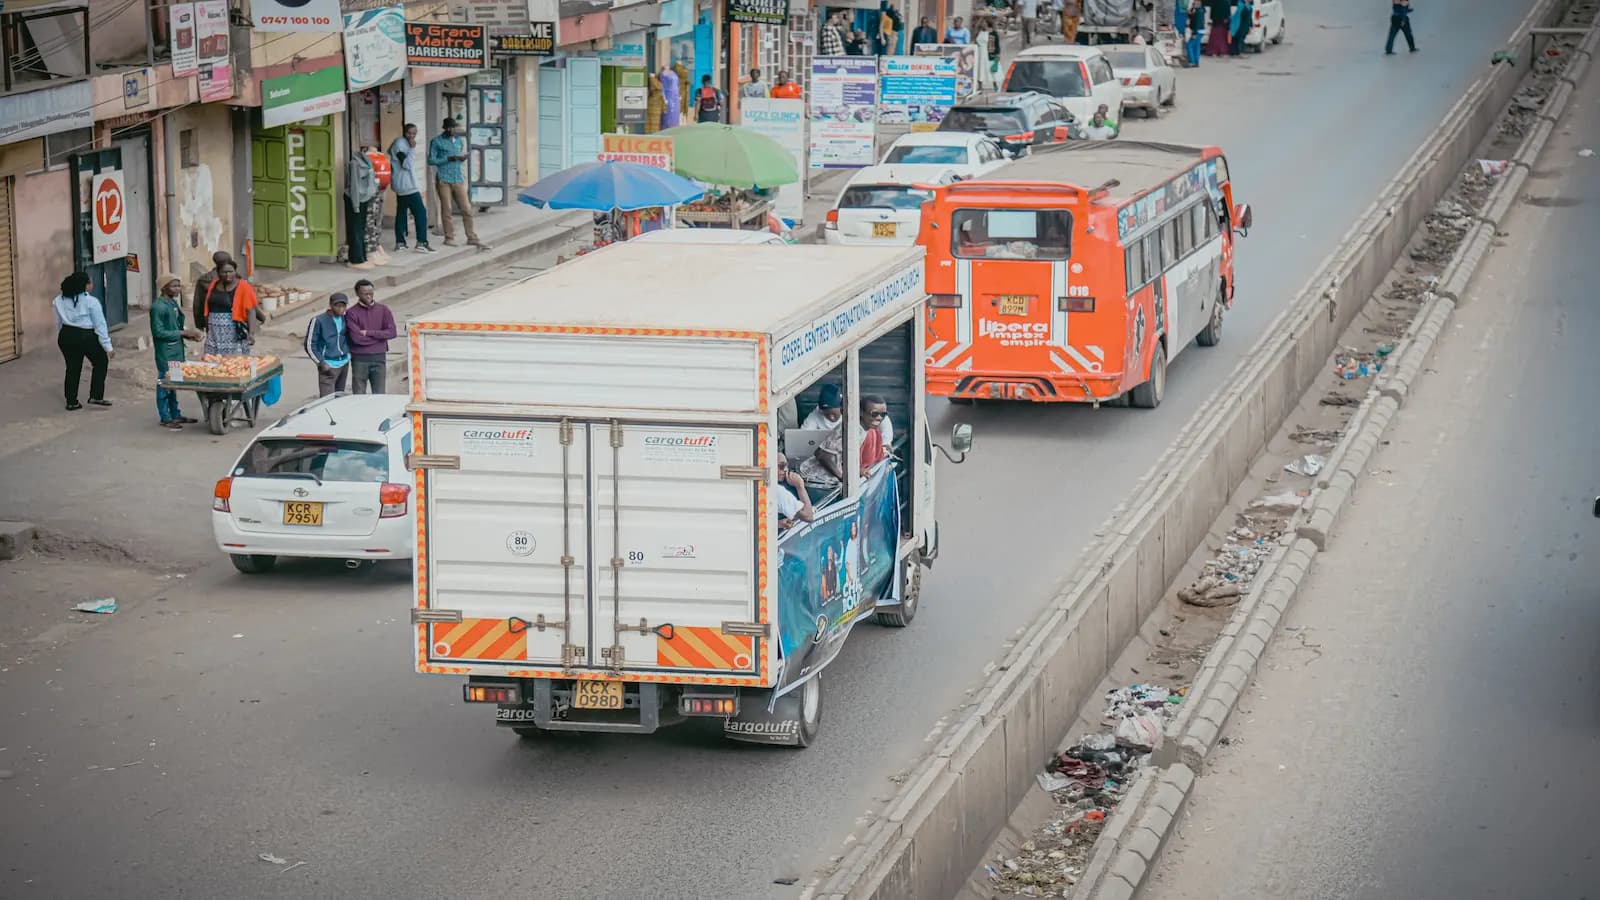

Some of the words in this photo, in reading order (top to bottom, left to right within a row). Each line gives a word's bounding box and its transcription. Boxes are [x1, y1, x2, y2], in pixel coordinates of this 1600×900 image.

[739, 0, 786, 10] WORLD
[747, 6, 784, 16] CYBER
[260, 16, 288, 25] 0747
[291, 17, 309, 25] 100
[312, 17, 330, 25] 100
[428, 25, 481, 38] Grand
[522, 23, 552, 38] ME
[415, 36, 475, 48] Maitre
[407, 46, 483, 59] BARBERSHOP
[934, 64, 957, 72] CLINIC
[287, 133, 310, 240] PESA
[97, 188, 121, 226] 12
[1007, 296, 1024, 305] KCD
[1001, 305, 1024, 313] 899M
[781, 337, 804, 366] GOSPEL
[804, 321, 829, 353] CENTRES
[830, 299, 871, 337] INTERNATIONAL
[870, 287, 887, 313] THIKA
[886, 279, 899, 302] ROAD
[900, 267, 920, 294] CHURCH
[463, 429, 528, 440] cargotuff
[645, 435, 710, 446] cargotuff
[287, 503, 311, 513] KCR
[287, 513, 319, 524] 795V
[514, 536, 528, 545] 80
[628, 551, 644, 561] 80
[579, 694, 619, 707] 098D
[496, 708, 550, 720] cargo
